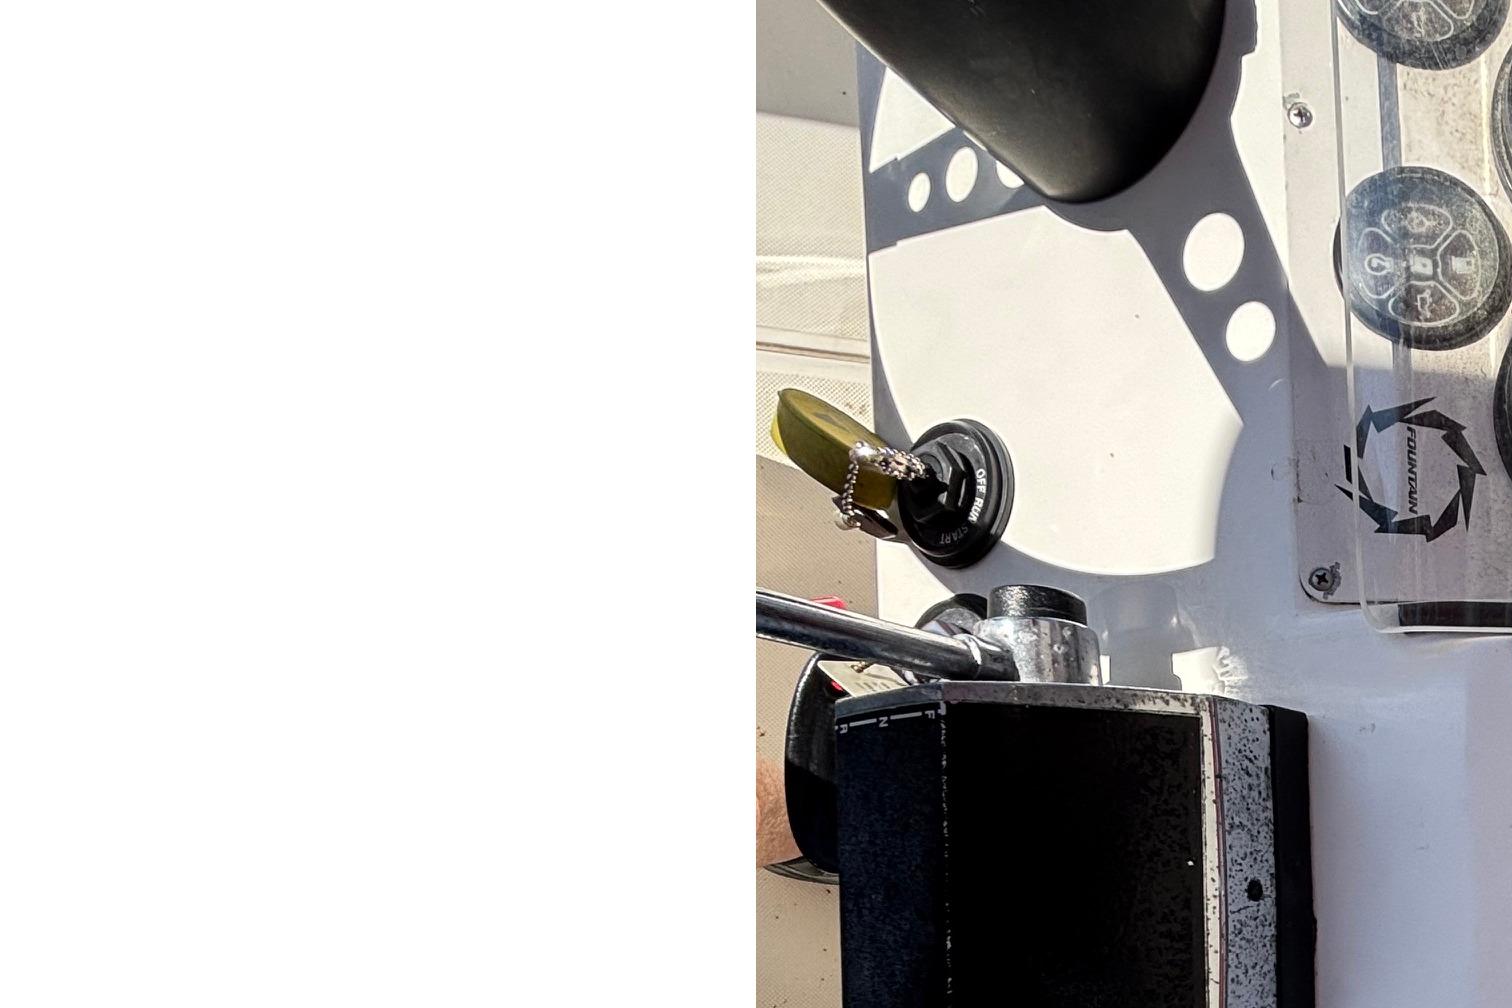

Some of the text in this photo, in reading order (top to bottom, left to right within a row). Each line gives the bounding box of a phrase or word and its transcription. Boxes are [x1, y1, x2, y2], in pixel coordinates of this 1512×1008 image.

[1406, 426, 1418, 515] FOUNTAIN
[940, 468, 986, 545] OFF RUN START
[878, 717, 889, 728] N
[924, 710, 935, 719] F
